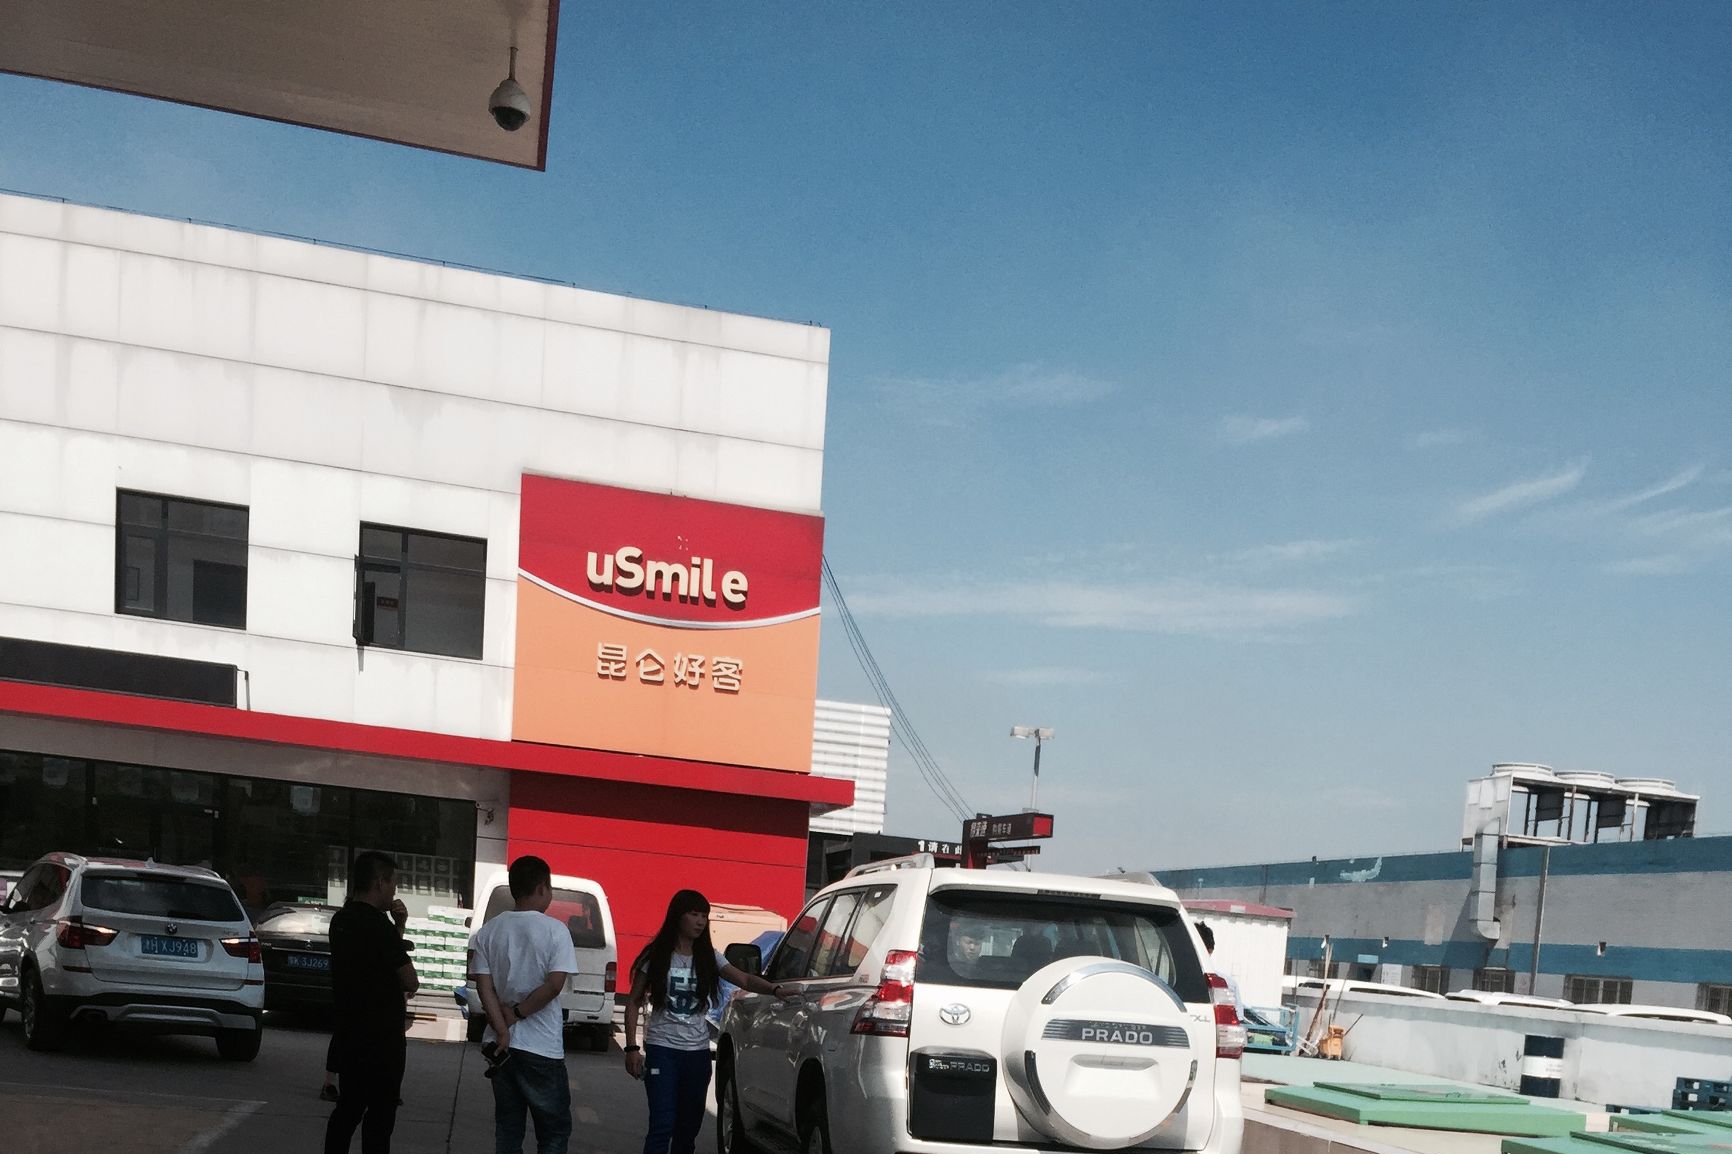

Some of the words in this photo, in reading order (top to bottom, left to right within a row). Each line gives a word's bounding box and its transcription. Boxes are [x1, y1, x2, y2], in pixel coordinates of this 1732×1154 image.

[586, 546, 748, 605] uSmile
[597, 642, 743, 692] 昆仑好客
[1081, 1027, 1153, 1044] PRADO
[950, 1061, 990, 1072] PRADO
